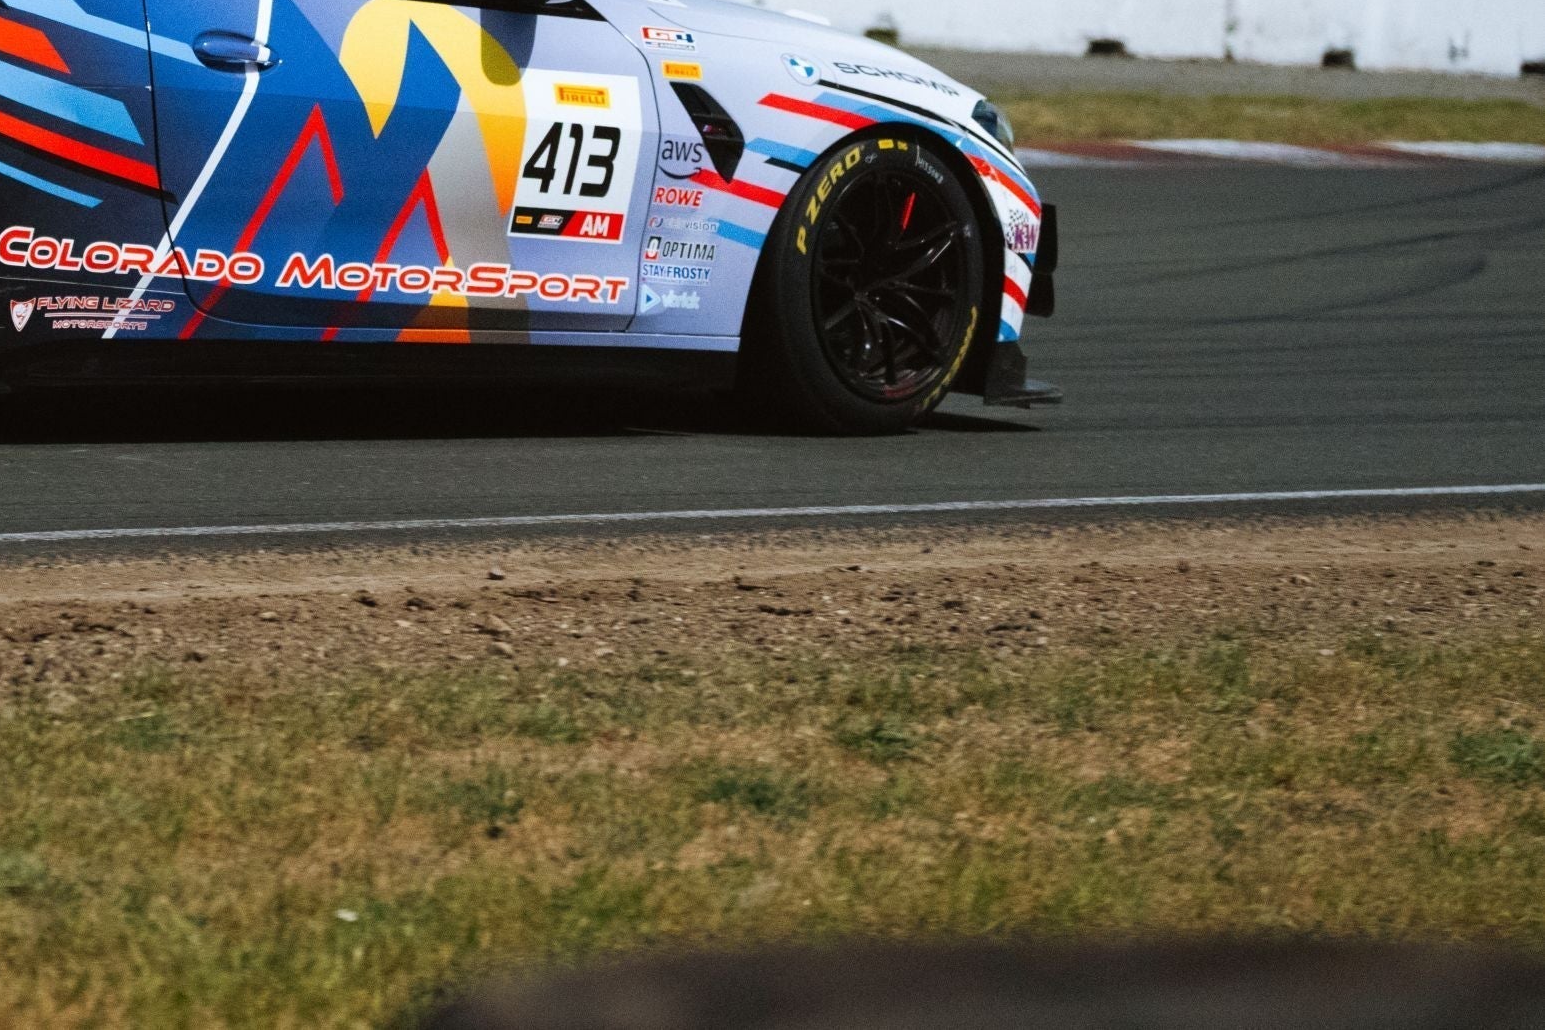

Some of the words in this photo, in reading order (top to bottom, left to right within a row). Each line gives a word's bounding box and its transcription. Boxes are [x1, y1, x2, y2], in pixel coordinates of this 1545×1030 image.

[833, 61, 960, 97] SCHOMP
[559, 86, 606, 105] PIRELLI
[522, 121, 622, 198] 413
[661, 139, 704, 163] aws
[654, 186, 704, 207] ROWE
[796, 225, 807, 255] P
[806, 147, 861, 225] ZERO
[579, 214, 611, 237] AM
[662, 241, 715, 261] OPTIMA
[643, 264, 665, 278] STAY
[666, 266, 711, 280] FROSTY
[37, 296, 99, 311] FLYING
[102, 297, 176, 313] LIZARD
[52, 320, 148, 331] MOTORSPORTS
